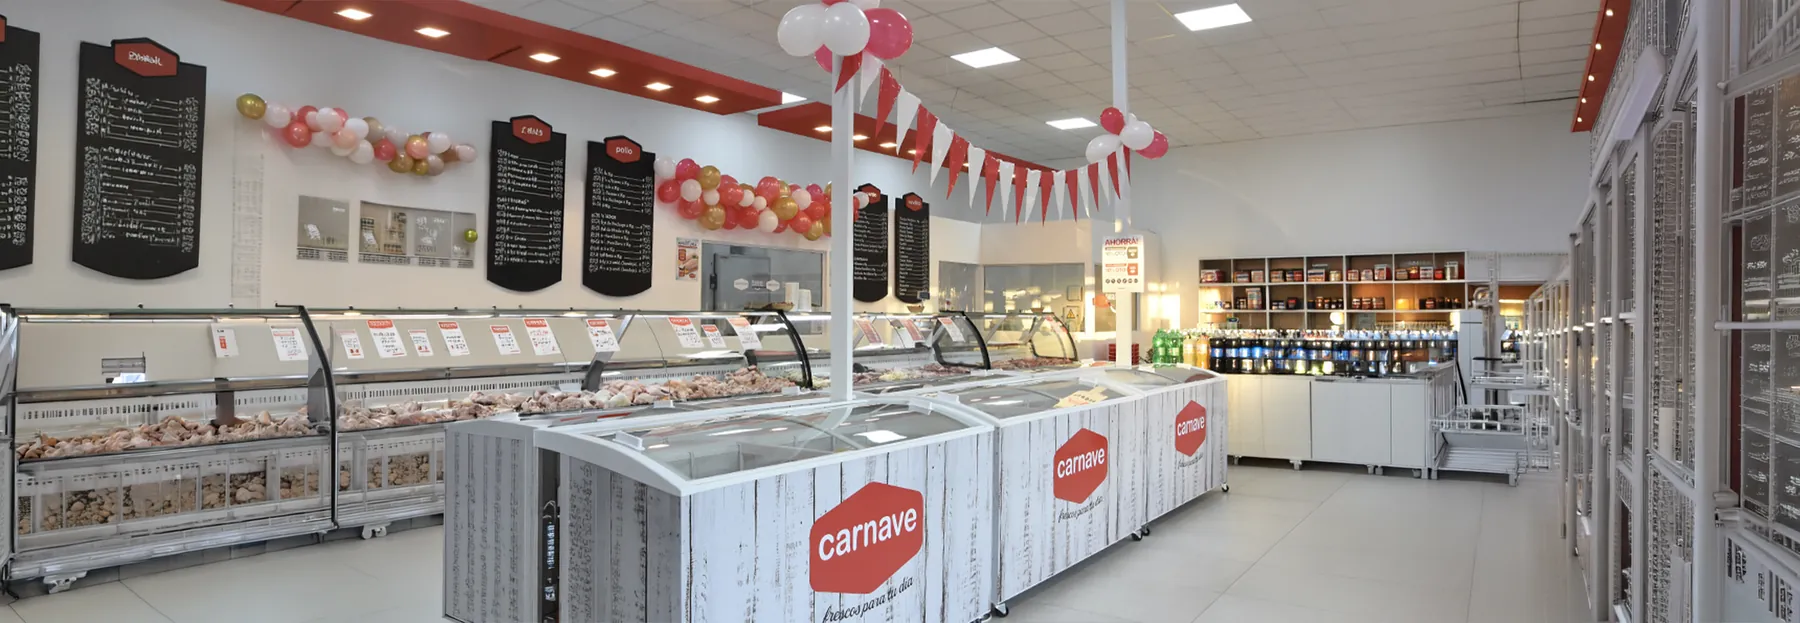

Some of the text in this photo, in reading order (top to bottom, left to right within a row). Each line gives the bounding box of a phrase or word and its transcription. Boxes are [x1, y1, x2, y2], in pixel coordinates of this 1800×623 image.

[1177, 416, 1205, 436] carnave
[1057, 448, 1105, 479] carnave
[818, 507, 917, 561] carnave
[822, 605, 861, 623] frescos
[860, 594, 886, 618] para
[887, 587, 897, 601] tu
